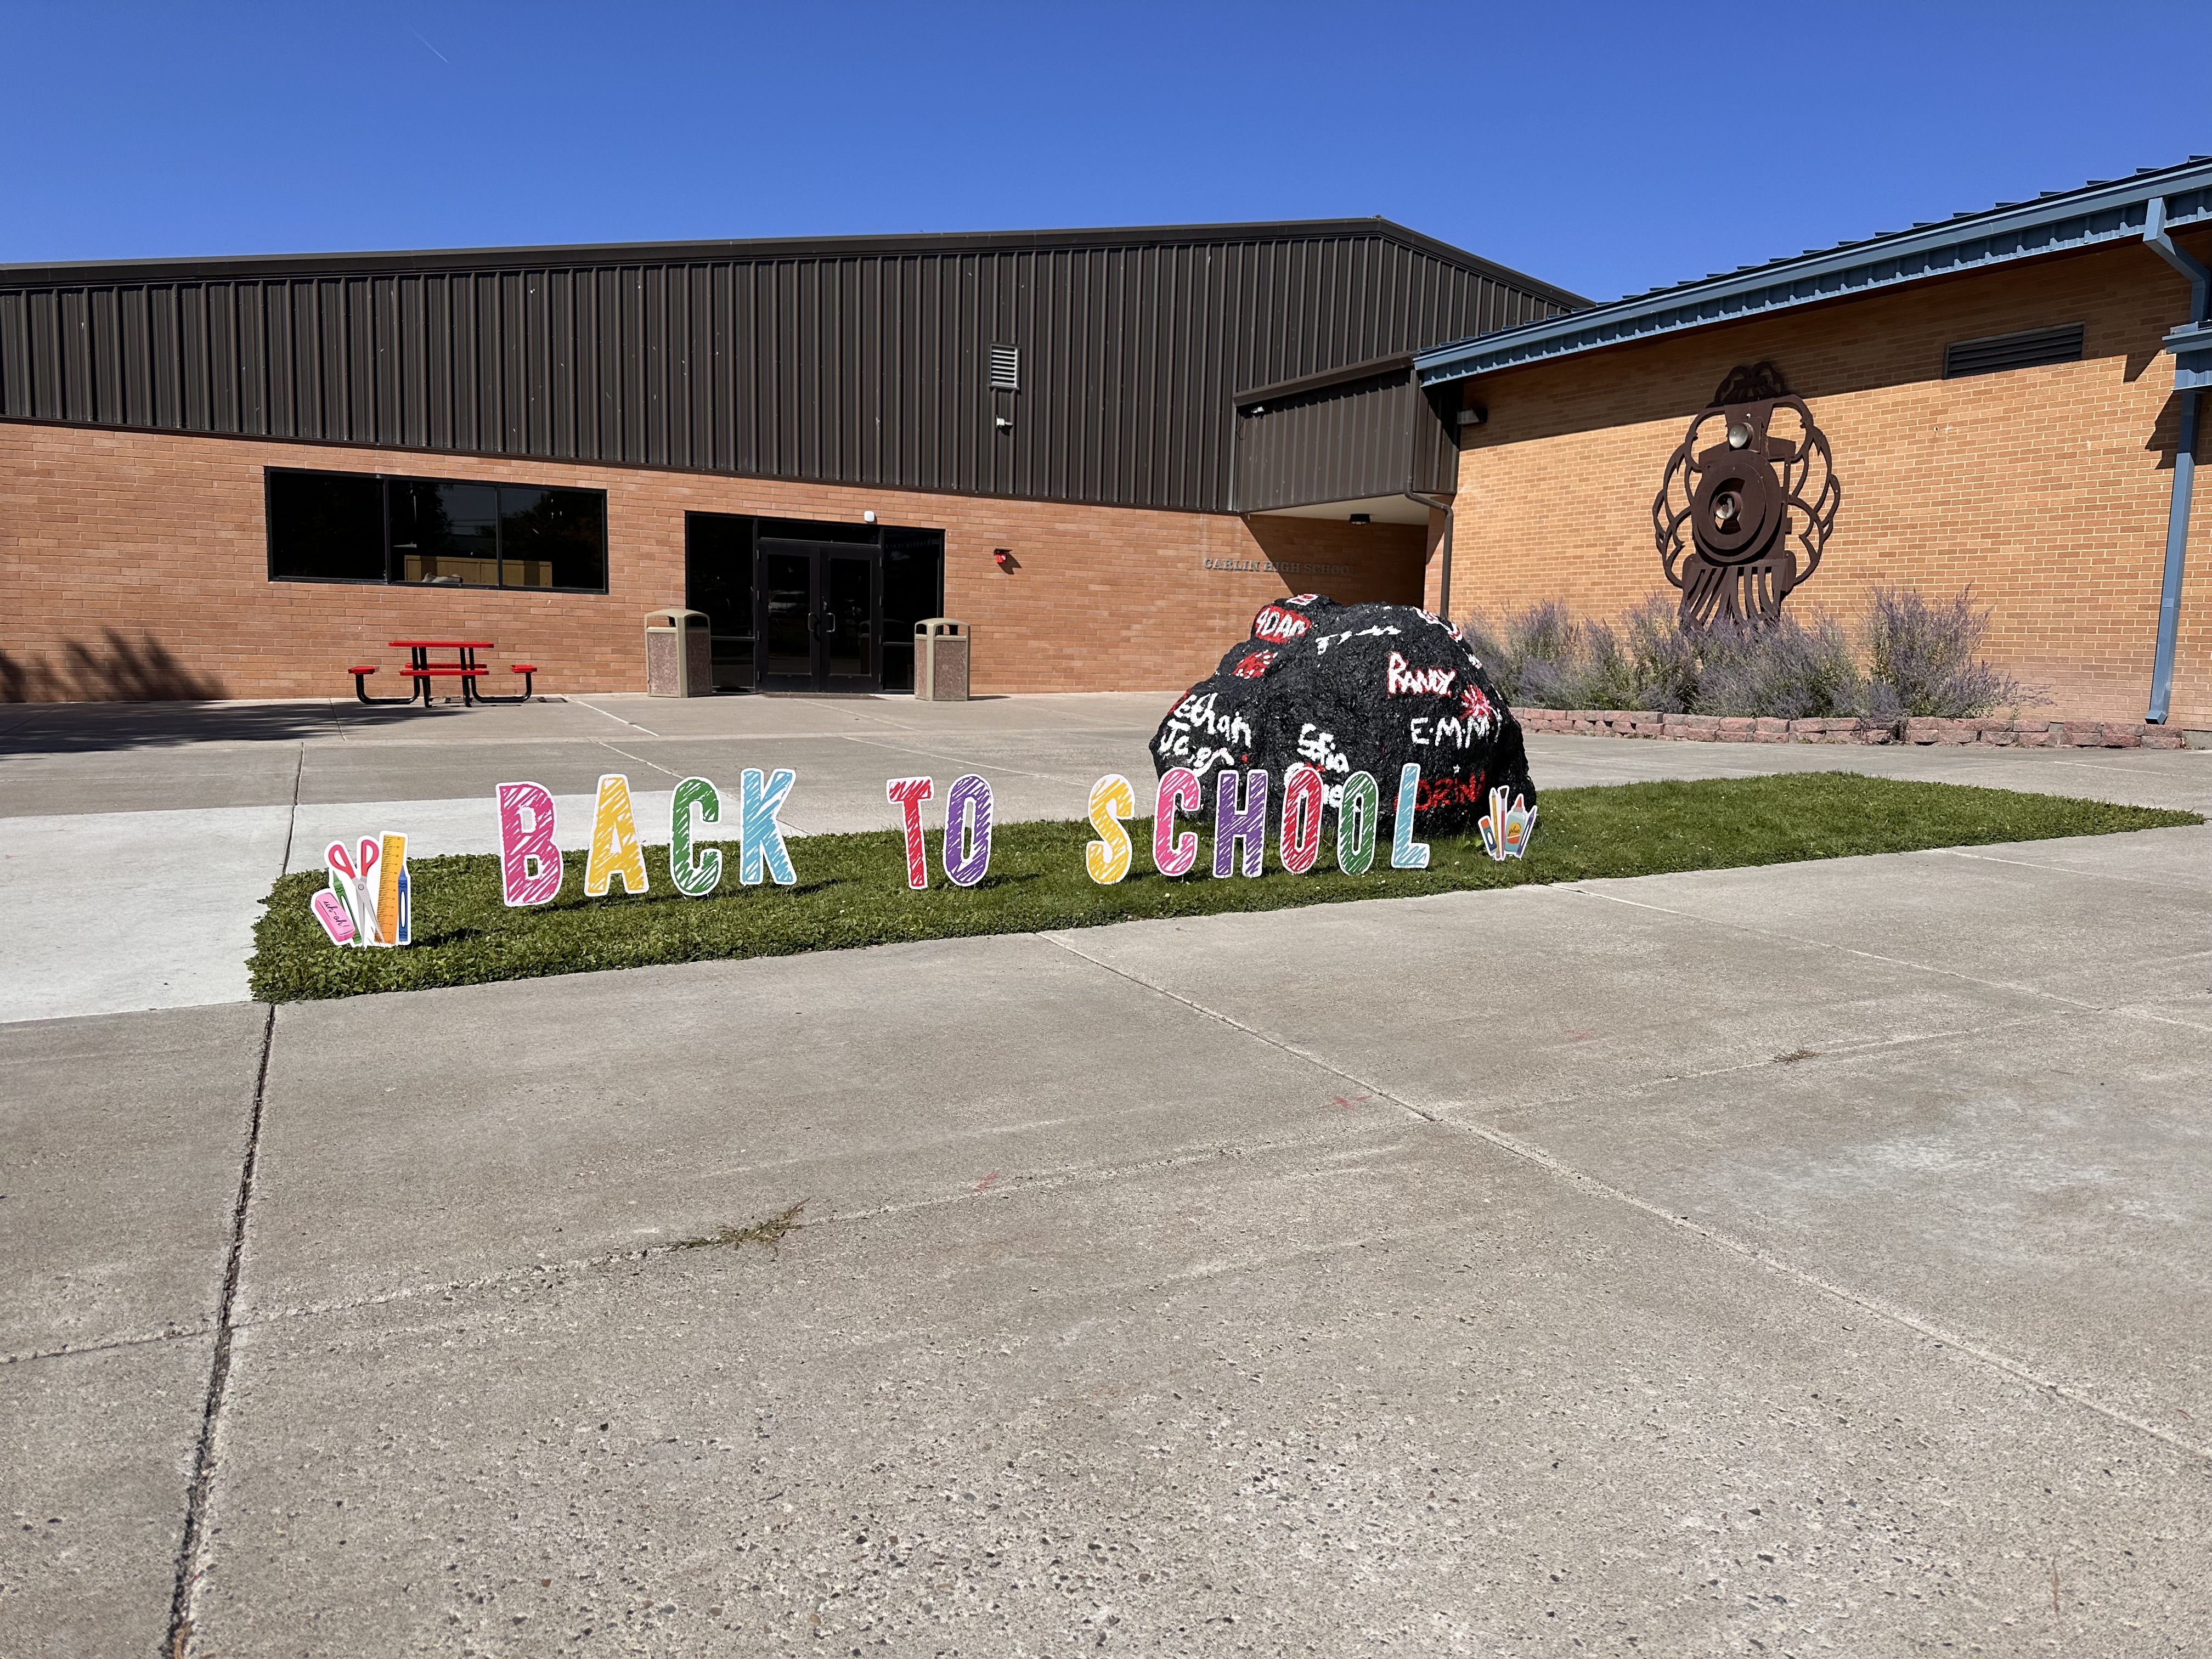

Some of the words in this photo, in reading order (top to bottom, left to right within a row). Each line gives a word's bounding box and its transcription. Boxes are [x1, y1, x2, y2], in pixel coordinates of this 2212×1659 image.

[1203, 557, 1260, 571] CARLIN
[1263, 561, 1300, 573] HIGH
[1304, 563, 1360, 575] SCHOOL
[496, 768, 796, 907] BACK
[887, 774, 994, 890] TO
[1086, 763, 1430, 885] SCHOOL
[1508, 825, 1520, 837] glue
